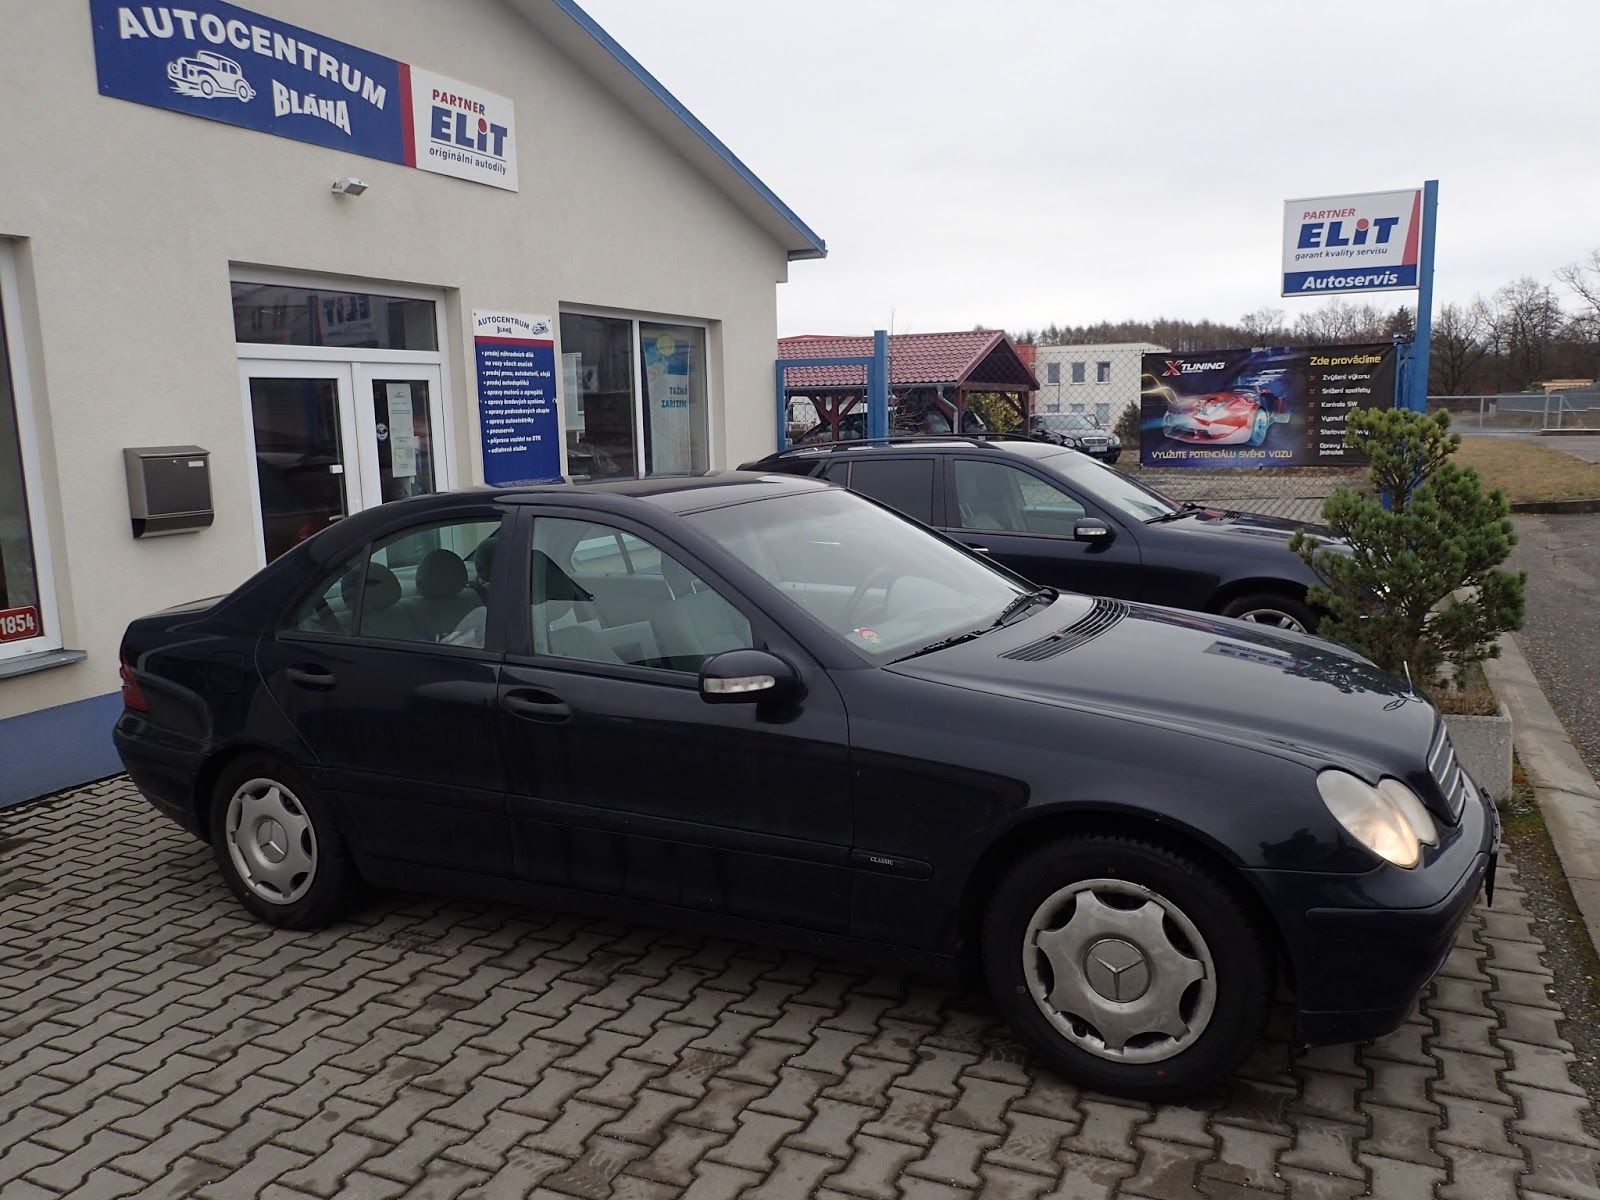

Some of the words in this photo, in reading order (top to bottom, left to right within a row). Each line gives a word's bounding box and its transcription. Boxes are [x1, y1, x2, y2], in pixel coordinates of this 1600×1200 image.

[118, 5, 388, 112] AUTOCENTRUM
[271, 78, 352, 136] BLÁHA
[432, 88, 487, 116] PARTNER
[1302, 208, 1356, 220] PARTNER
[1294, 251, 1323, 262] garant
[1324, 248, 1355, 259] kvality
[1356, 247, 1388, 256] servisu
[1301, 270, 1399, 290] Autoservis
[478, 316, 530, 330] AUTOCENTRUM
[484, 350, 500, 358] prodej
[1310, 356, 1330, 366] Zde
[1330, 355, 1382, 366] provádíme
[486, 379, 502, 387] prodej
[1322, 373, 1347, 381] Zvýšení
[1319, 442, 1341, 450] Opravy
[1151, 449, 1187, 459] VYUŽIJTE
[1189, 449, 1237, 459] POTENCIÁLU
[1238, 448, 1266, 458] SVÉHO
[1268, 450, 1293, 458] VOZU
[0, 613, 35, 635] 1854
[869, 856, 894, 866] CLASSIC
